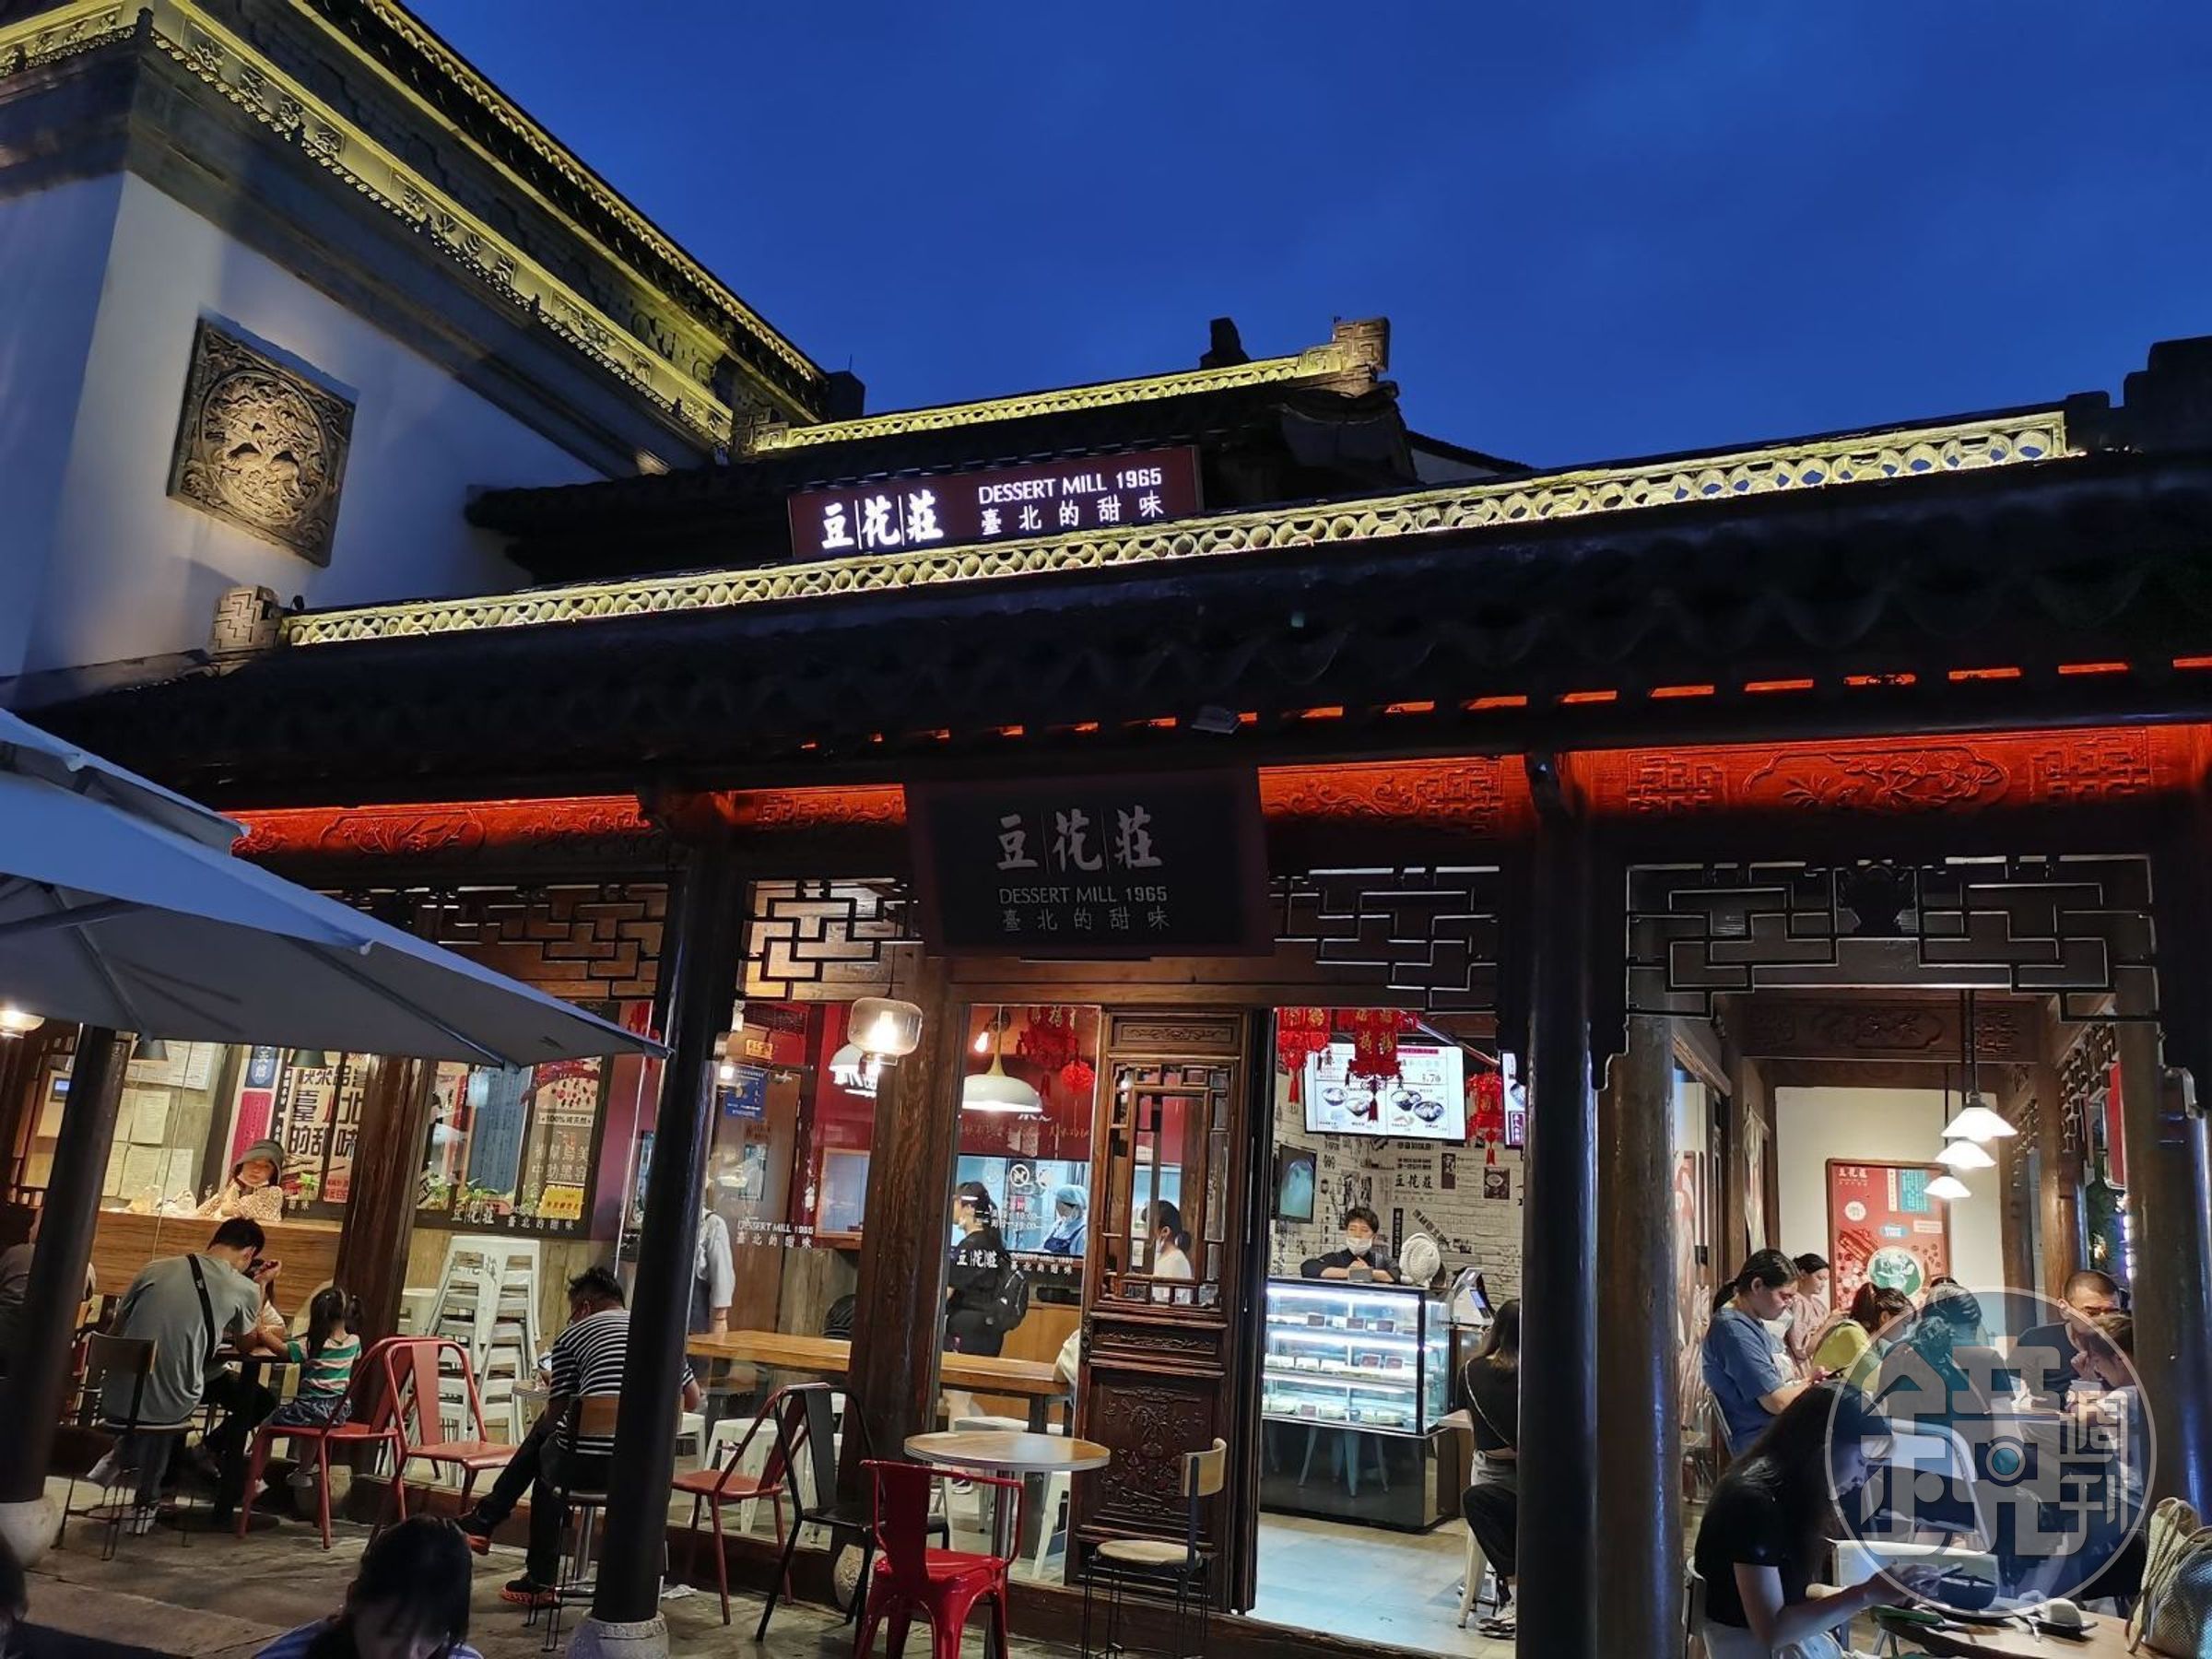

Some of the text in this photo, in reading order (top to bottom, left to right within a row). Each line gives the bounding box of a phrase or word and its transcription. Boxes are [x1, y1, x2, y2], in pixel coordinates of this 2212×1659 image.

[978, 468, 1162, 505] DESSERT MILL 1965
[821, 488, 944, 550] 豆花莊
[981, 489, 1164, 535] 臺北的甜味
[995, 805, 1163, 872] 豆花莊
[998, 885, 1168, 905] DESSERT MILL 1965
[1002, 905, 1172, 932] 臺北的甜味
